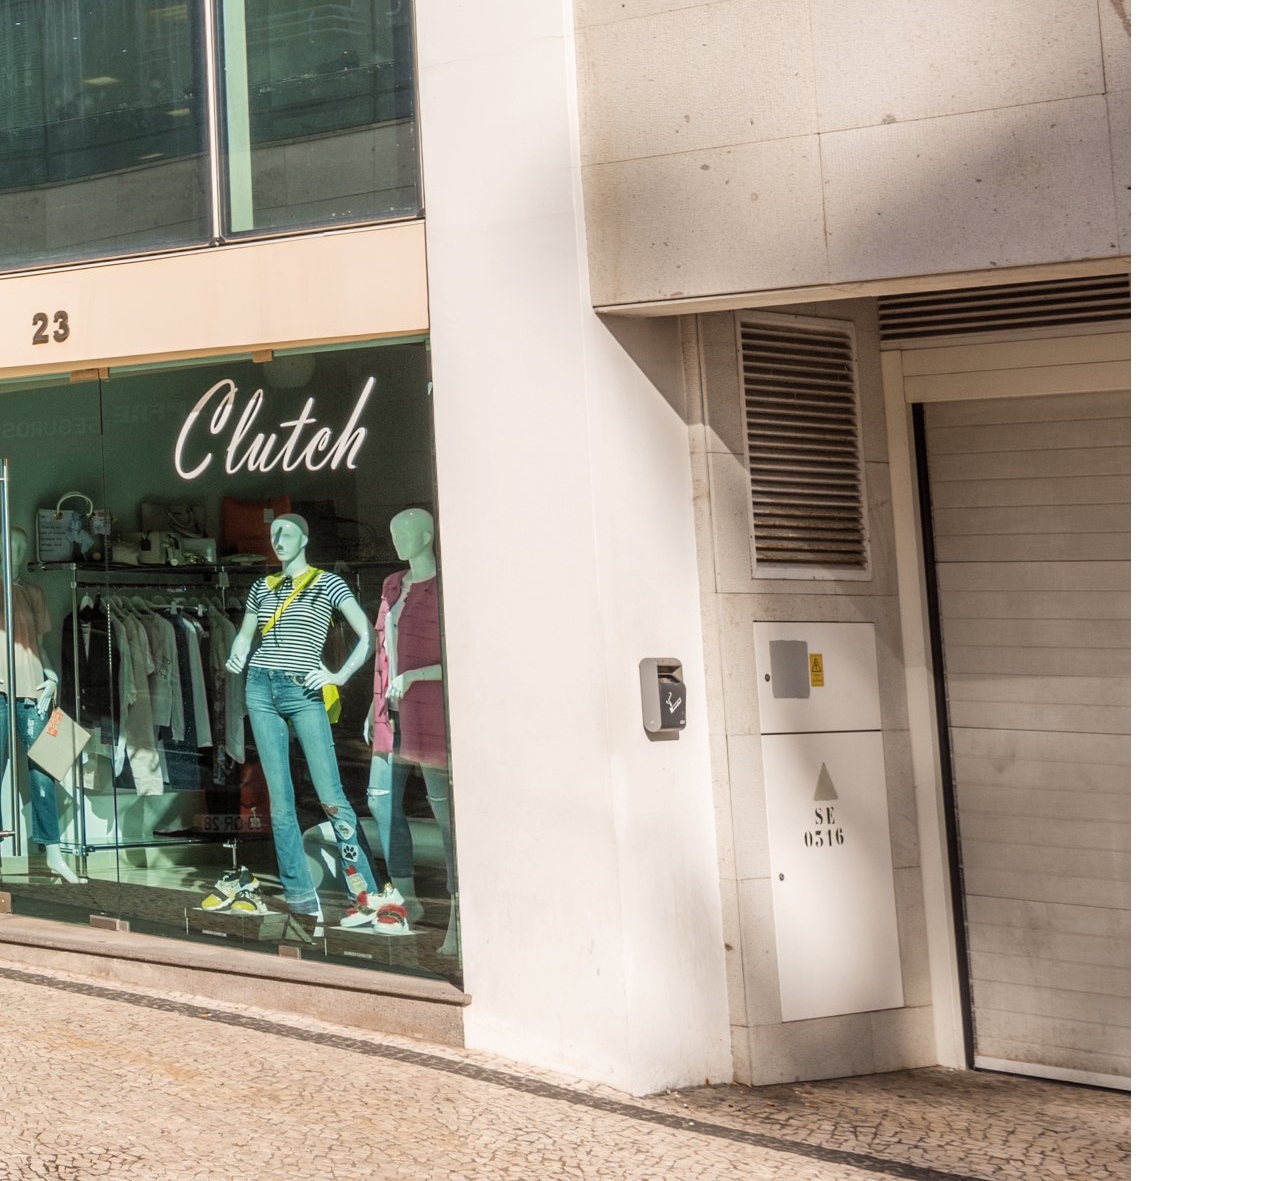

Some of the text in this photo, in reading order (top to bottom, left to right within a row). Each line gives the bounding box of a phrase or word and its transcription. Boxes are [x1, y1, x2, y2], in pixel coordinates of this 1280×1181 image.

[31, 310, 70, 345] 23
[175, 377, 376, 480] Clutch
[814, 806, 835, 825] SE
[804, 827, 845, 848] 0516
